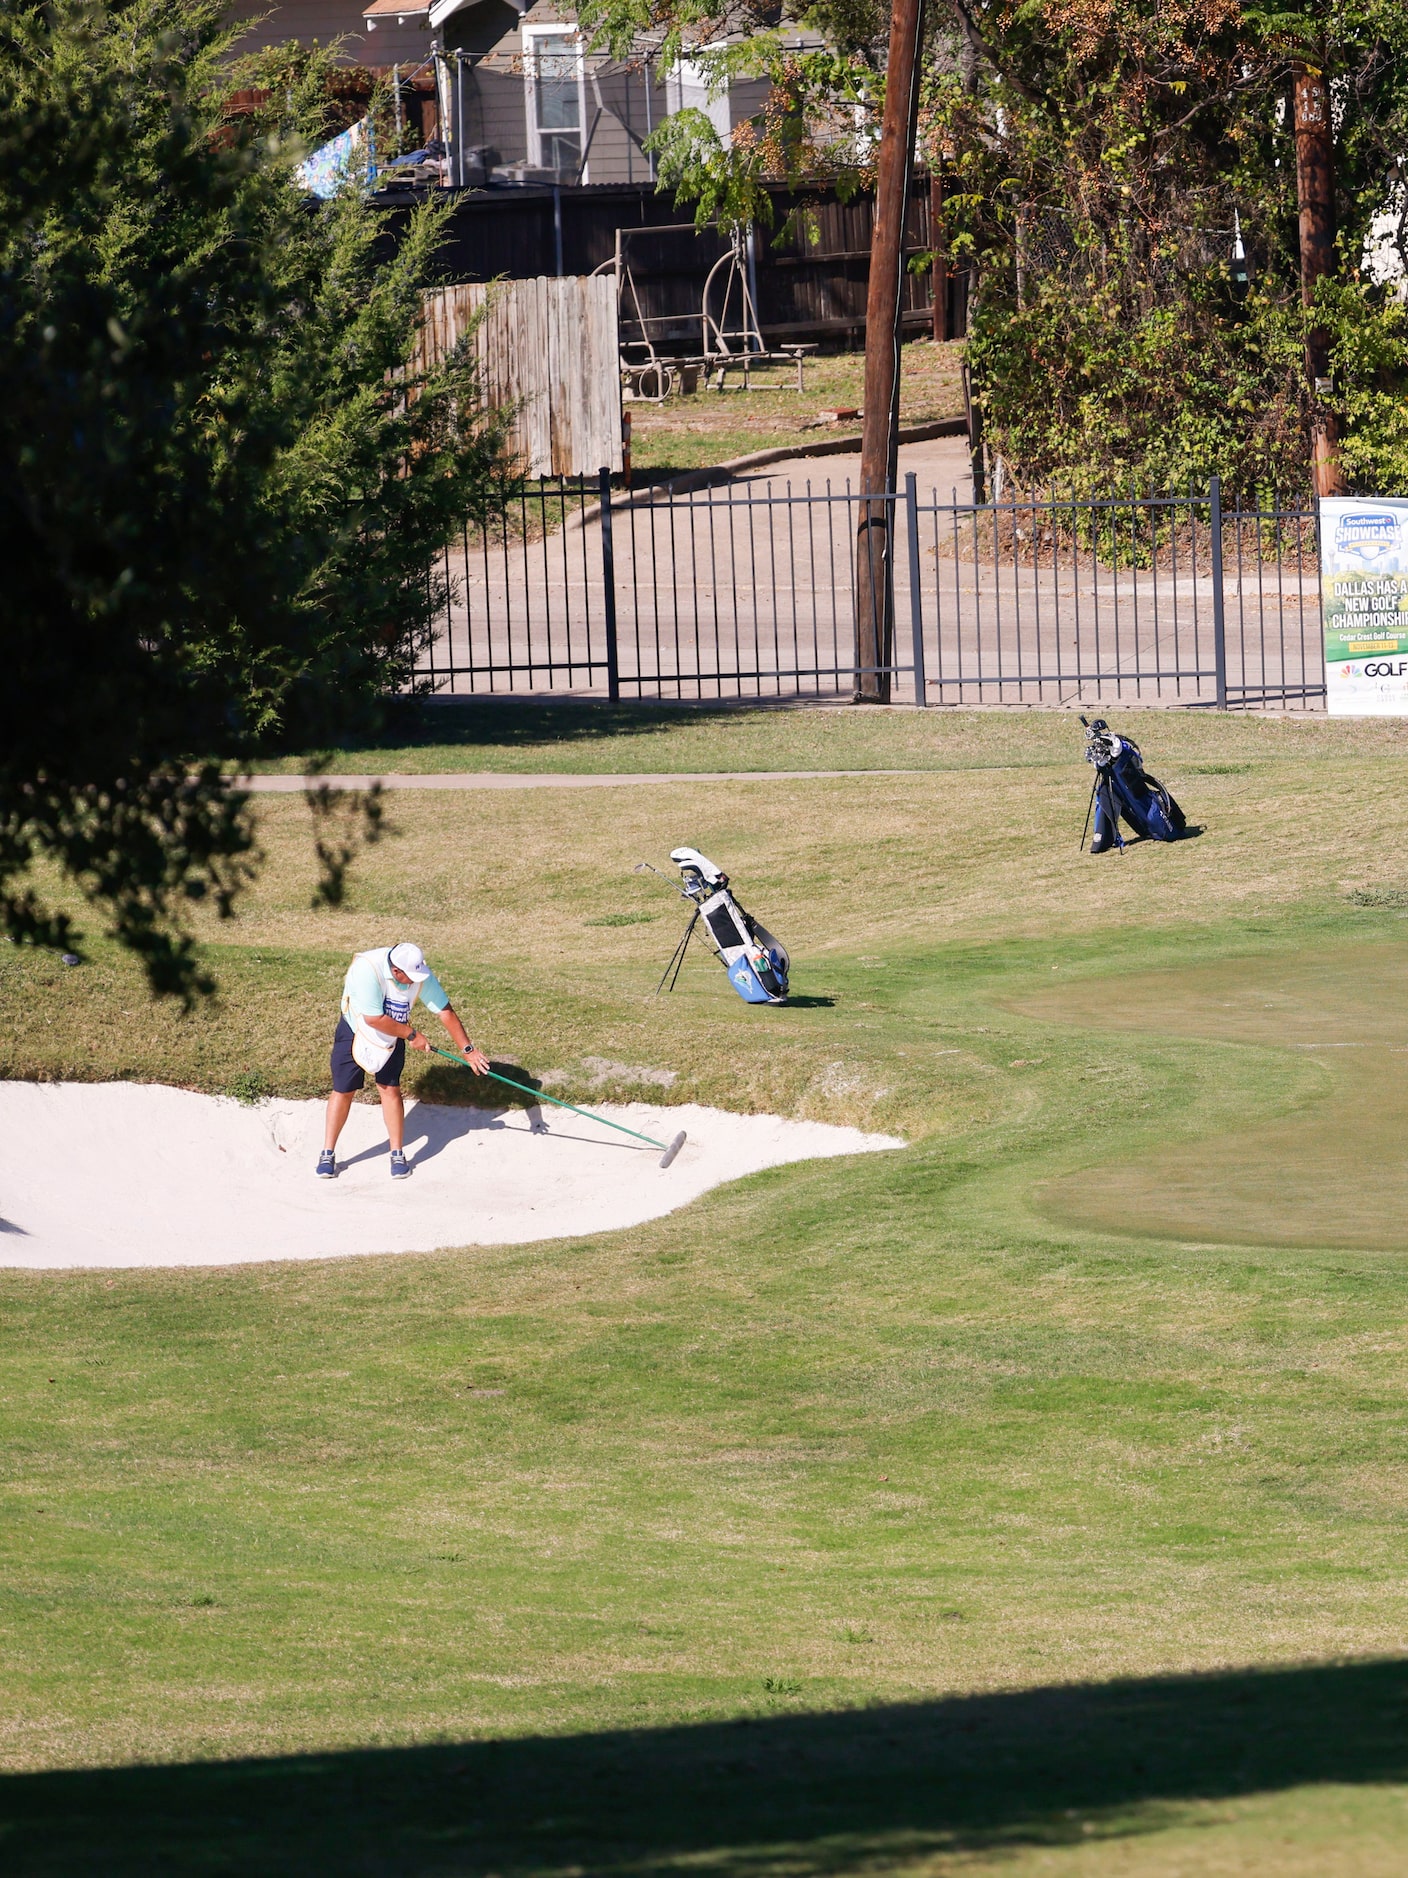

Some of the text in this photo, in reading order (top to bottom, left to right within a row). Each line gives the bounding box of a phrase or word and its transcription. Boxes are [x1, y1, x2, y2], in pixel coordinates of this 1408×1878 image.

[1346, 517, 1386, 525] Southwest
[1335, 525, 1401, 543] SHOWCASE
[1334, 579, 1408, 596] DALLAS HAS A
[1345, 596, 1397, 611] NEW GOLF
[1339, 631, 1406, 642] Cedar Crest Golf Course
[1364, 662, 1408, 677] GOLF
